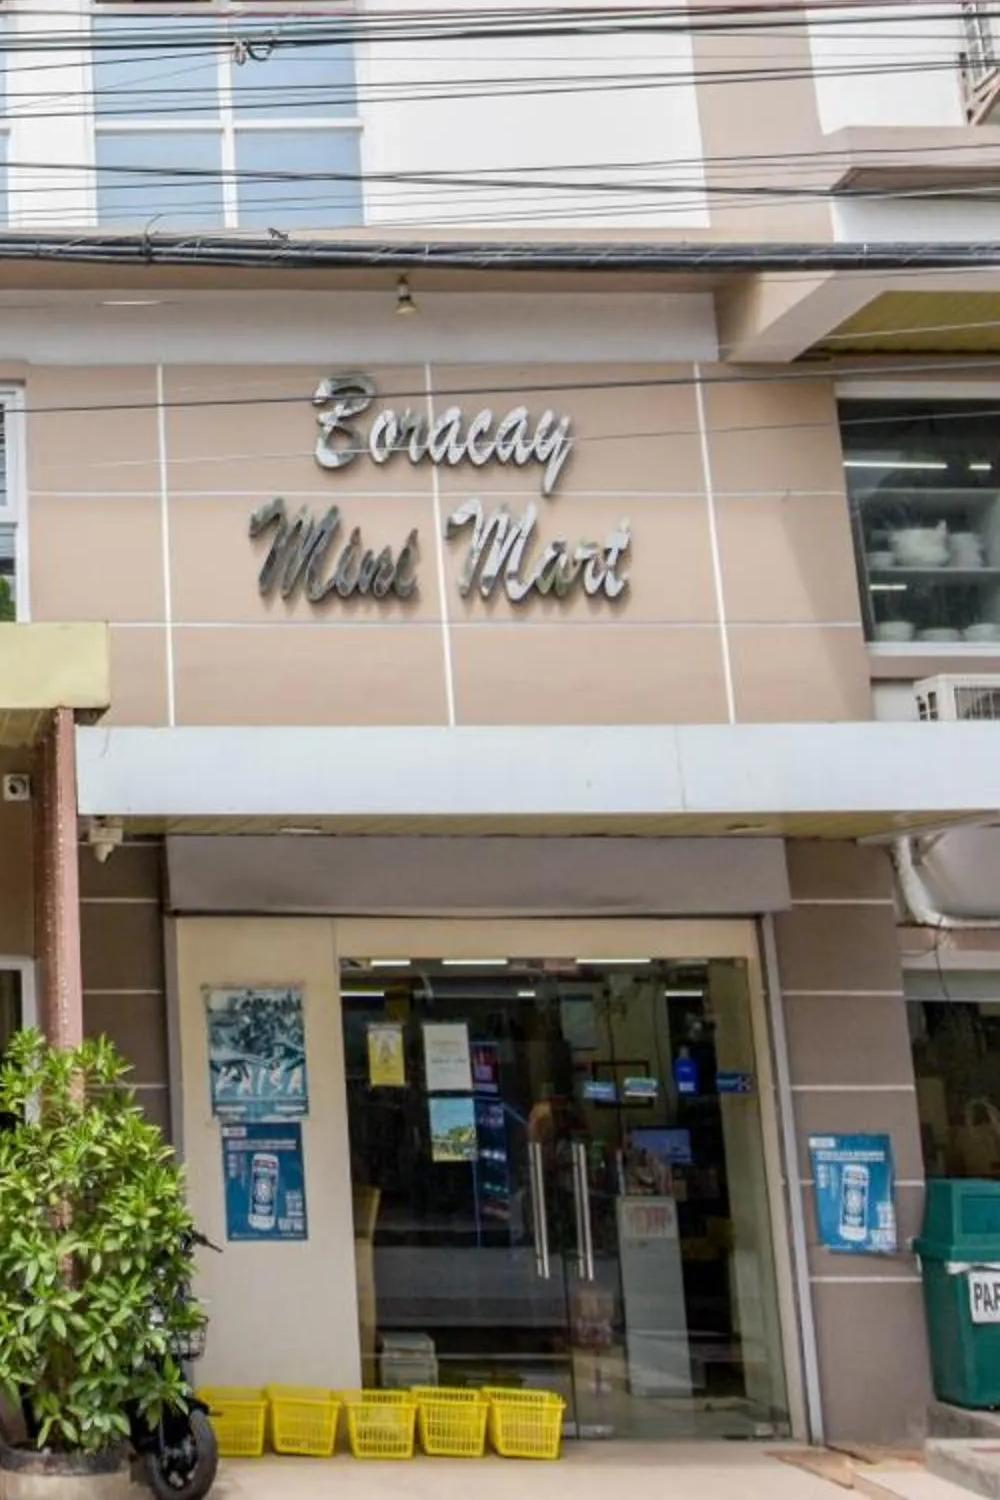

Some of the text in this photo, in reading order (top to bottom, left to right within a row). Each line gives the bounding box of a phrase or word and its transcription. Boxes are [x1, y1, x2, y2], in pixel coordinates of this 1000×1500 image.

[312, 372, 575, 498] Boracay
[249, 497, 631, 601] Mini Mart
